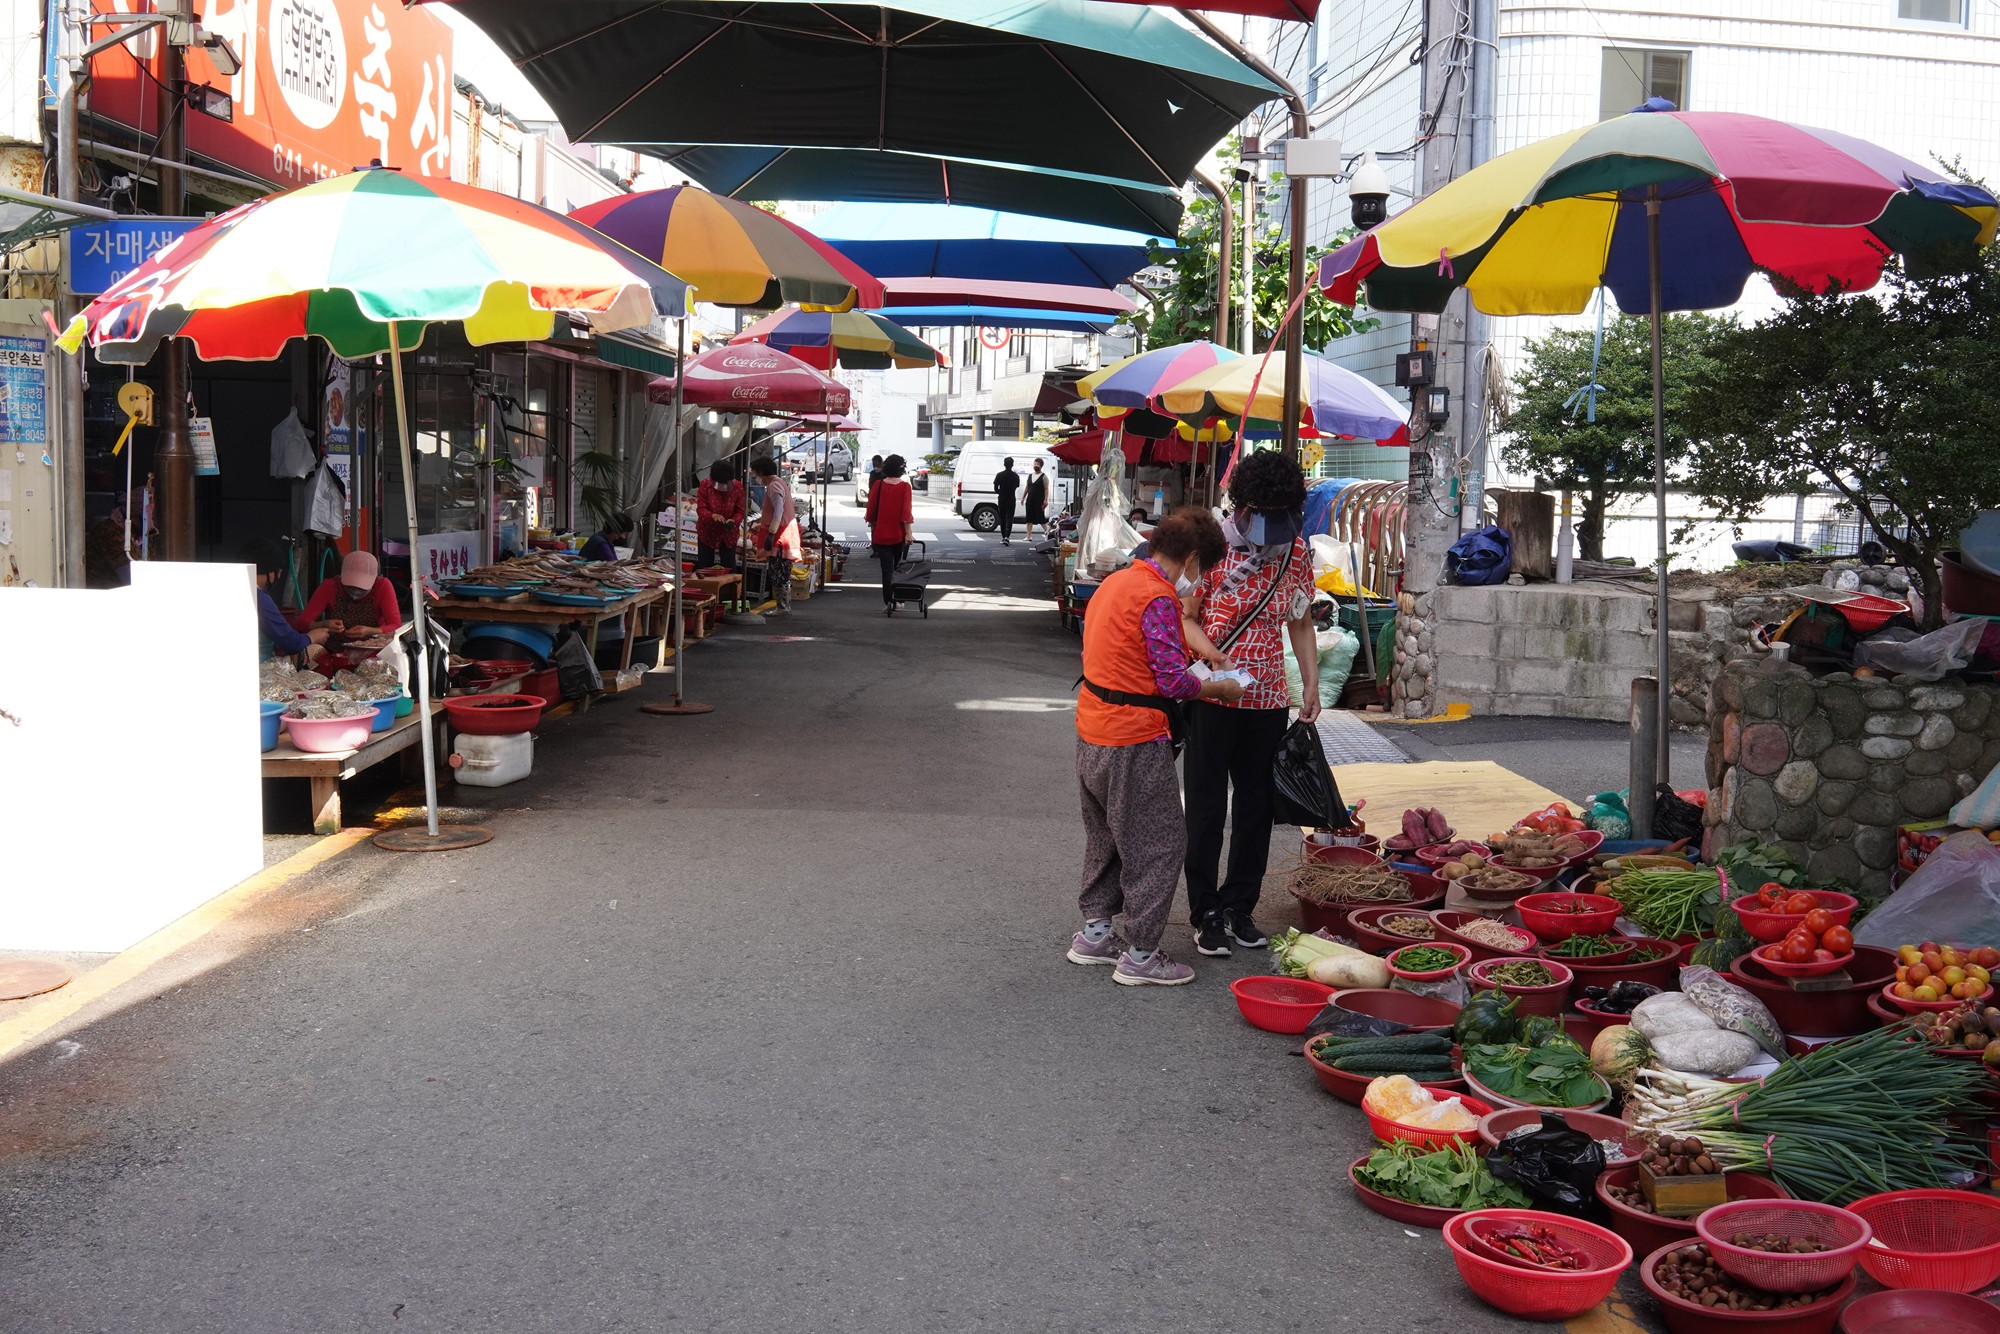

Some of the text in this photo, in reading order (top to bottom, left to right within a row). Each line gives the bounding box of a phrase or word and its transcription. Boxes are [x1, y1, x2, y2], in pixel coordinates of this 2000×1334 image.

[273, 143, 345, 182] 641-15
[84, 229, 180, 264] 자매생
[723, 356, 779, 368] Coca-Cola
[732, 386, 769, 398] Coca-Cola
